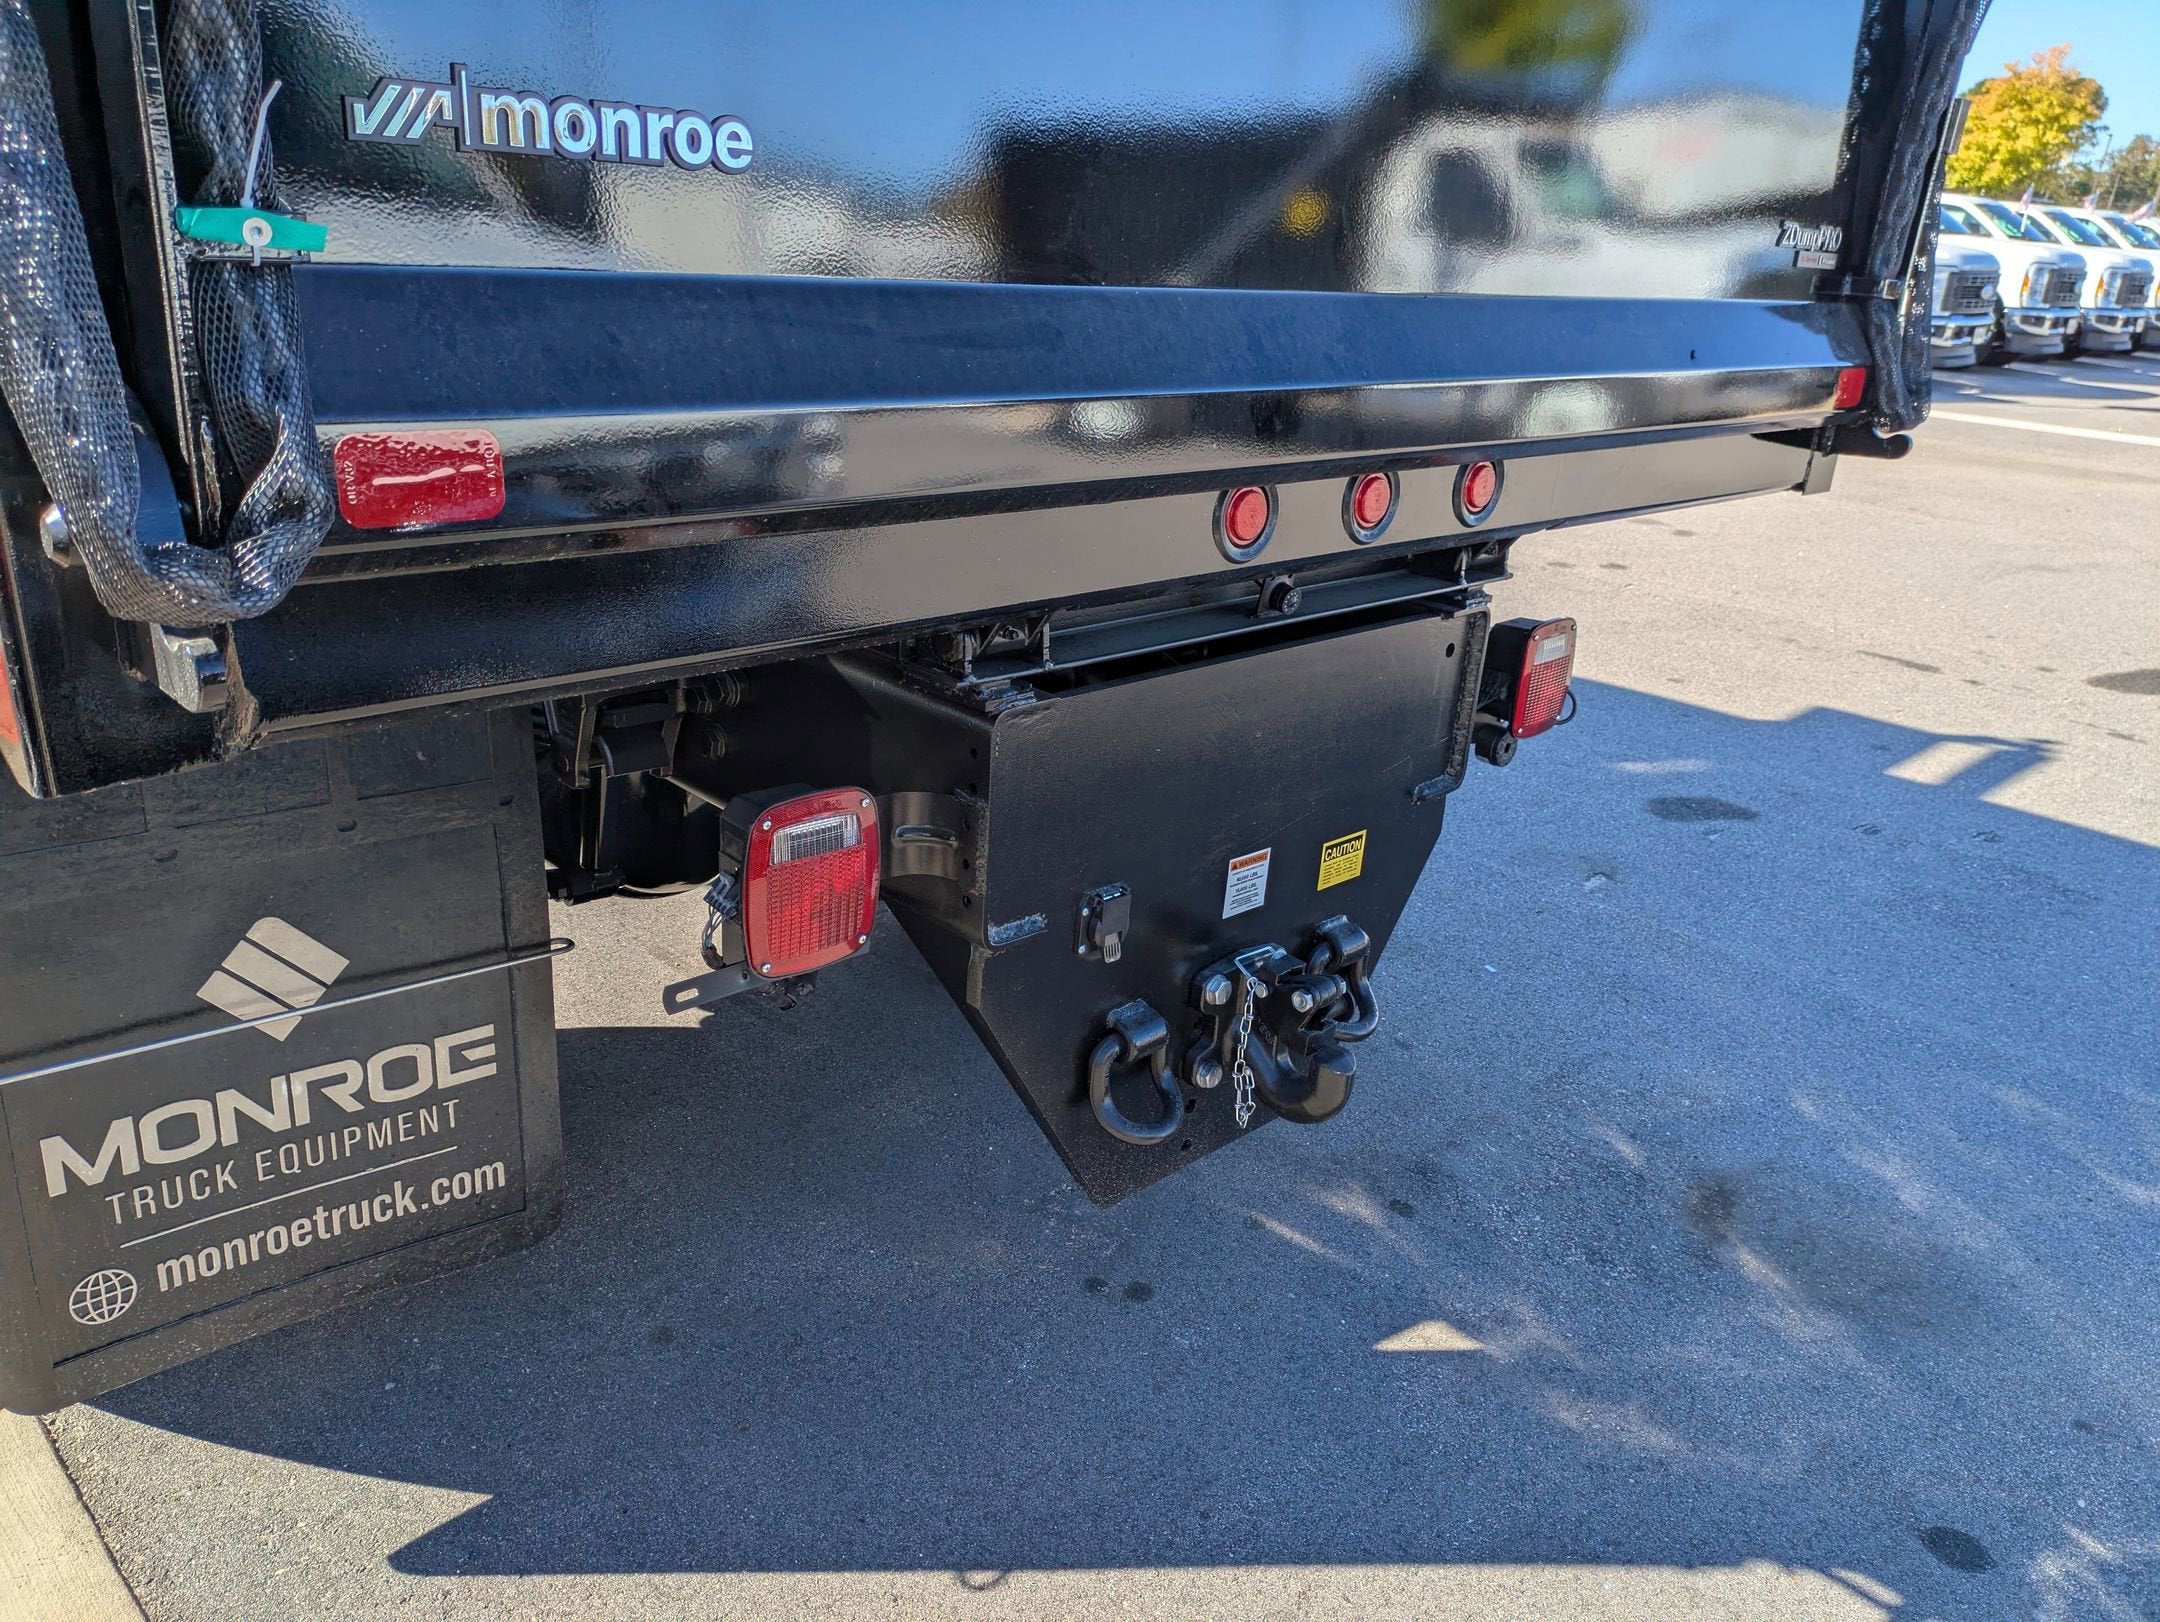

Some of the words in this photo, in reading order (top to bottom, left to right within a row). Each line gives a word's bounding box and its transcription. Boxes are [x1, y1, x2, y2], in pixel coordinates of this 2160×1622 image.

[480, 93, 754, 170] monroe
[1238, 853, 1267, 868] WARNING
[1325, 838, 1362, 861] CAUTION
[40, 1023, 498, 1197] MONROE
[105, 1160, 238, 1225] TRUCK
[255, 1099, 460, 1181] EQUIPMENT
[156, 1160, 506, 1292] monroetruck.com
